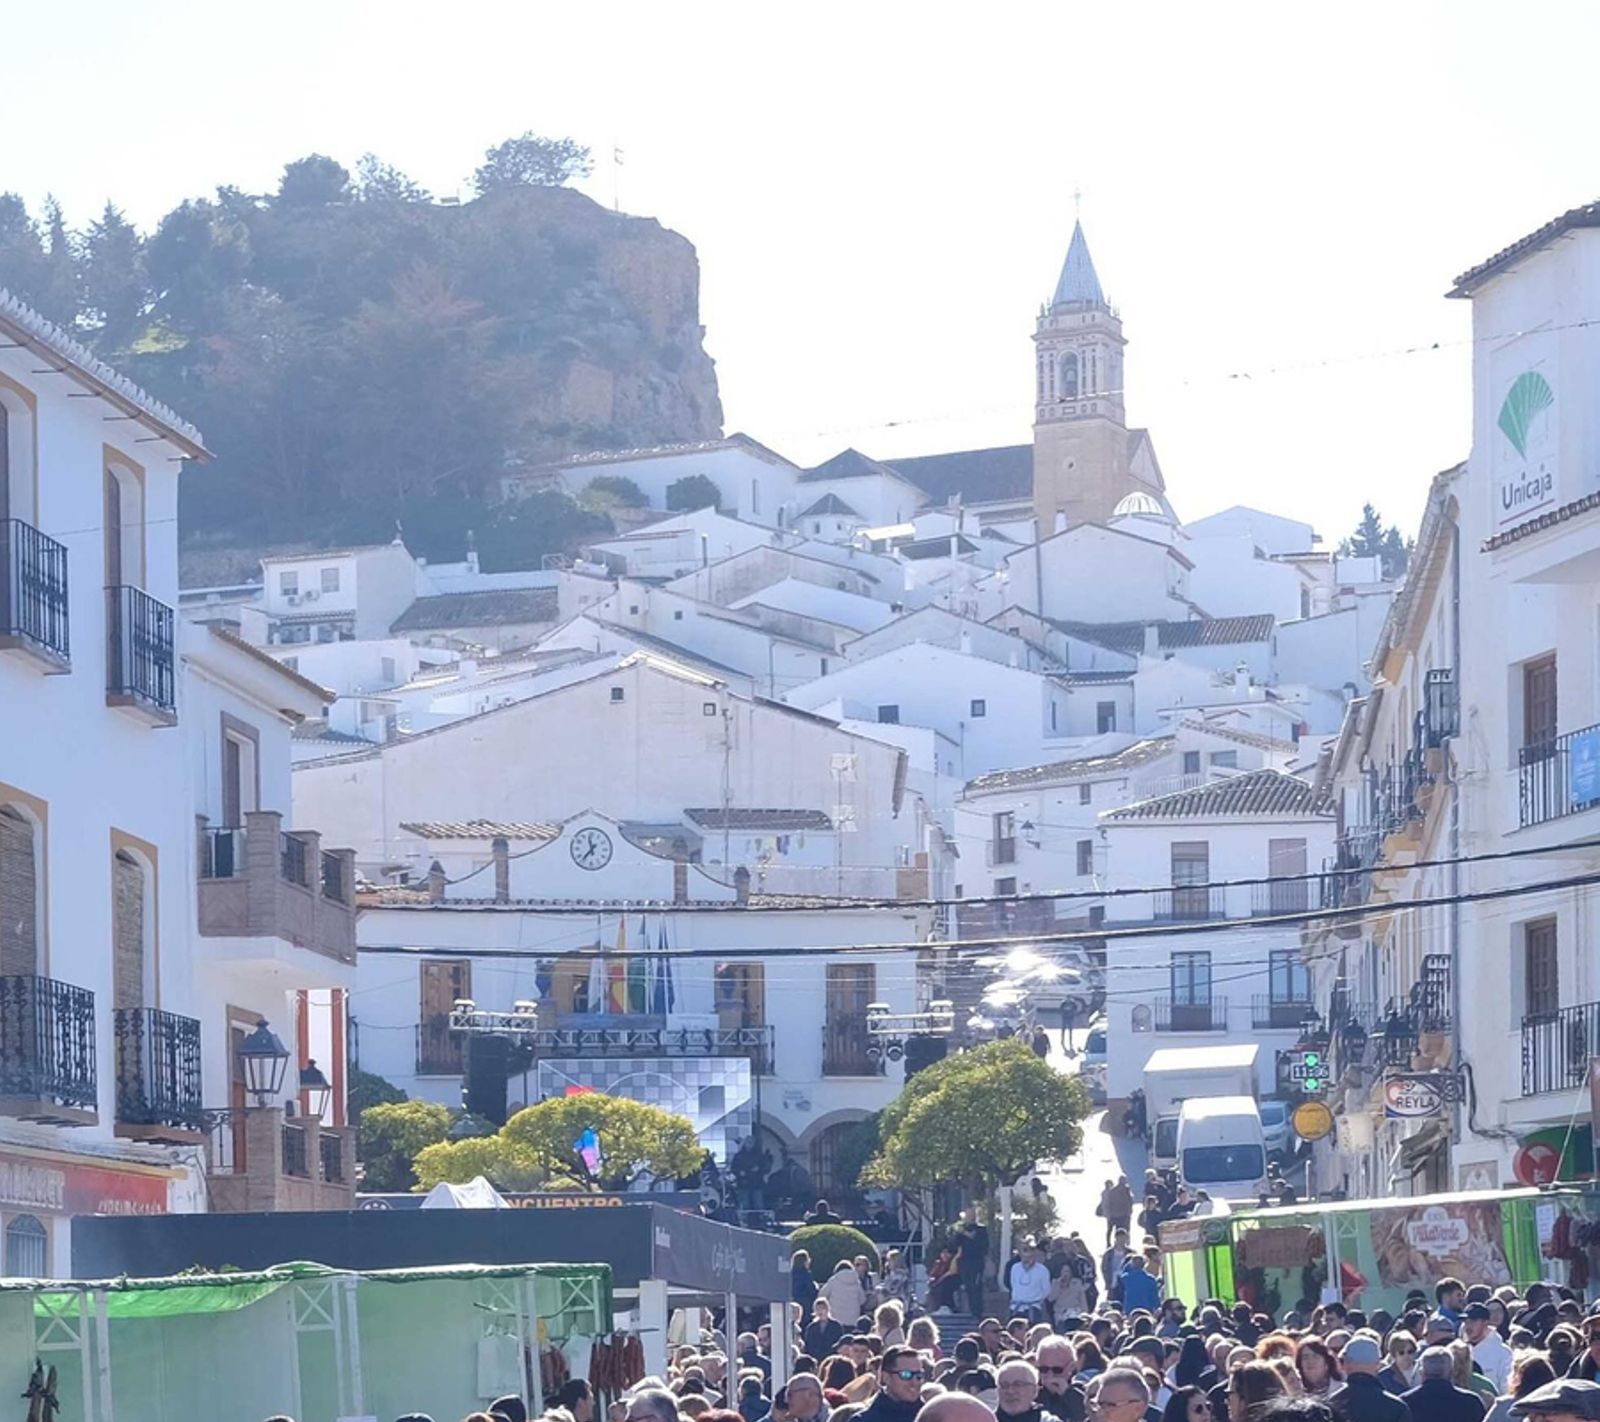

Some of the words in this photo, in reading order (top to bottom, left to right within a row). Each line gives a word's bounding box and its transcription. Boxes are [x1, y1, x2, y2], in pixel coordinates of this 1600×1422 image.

[1501, 463, 1553, 510] Unicaja
[1396, 1096, 1435, 1109] REYLA
[507, 1198, 624, 1208] NCUENTRO
